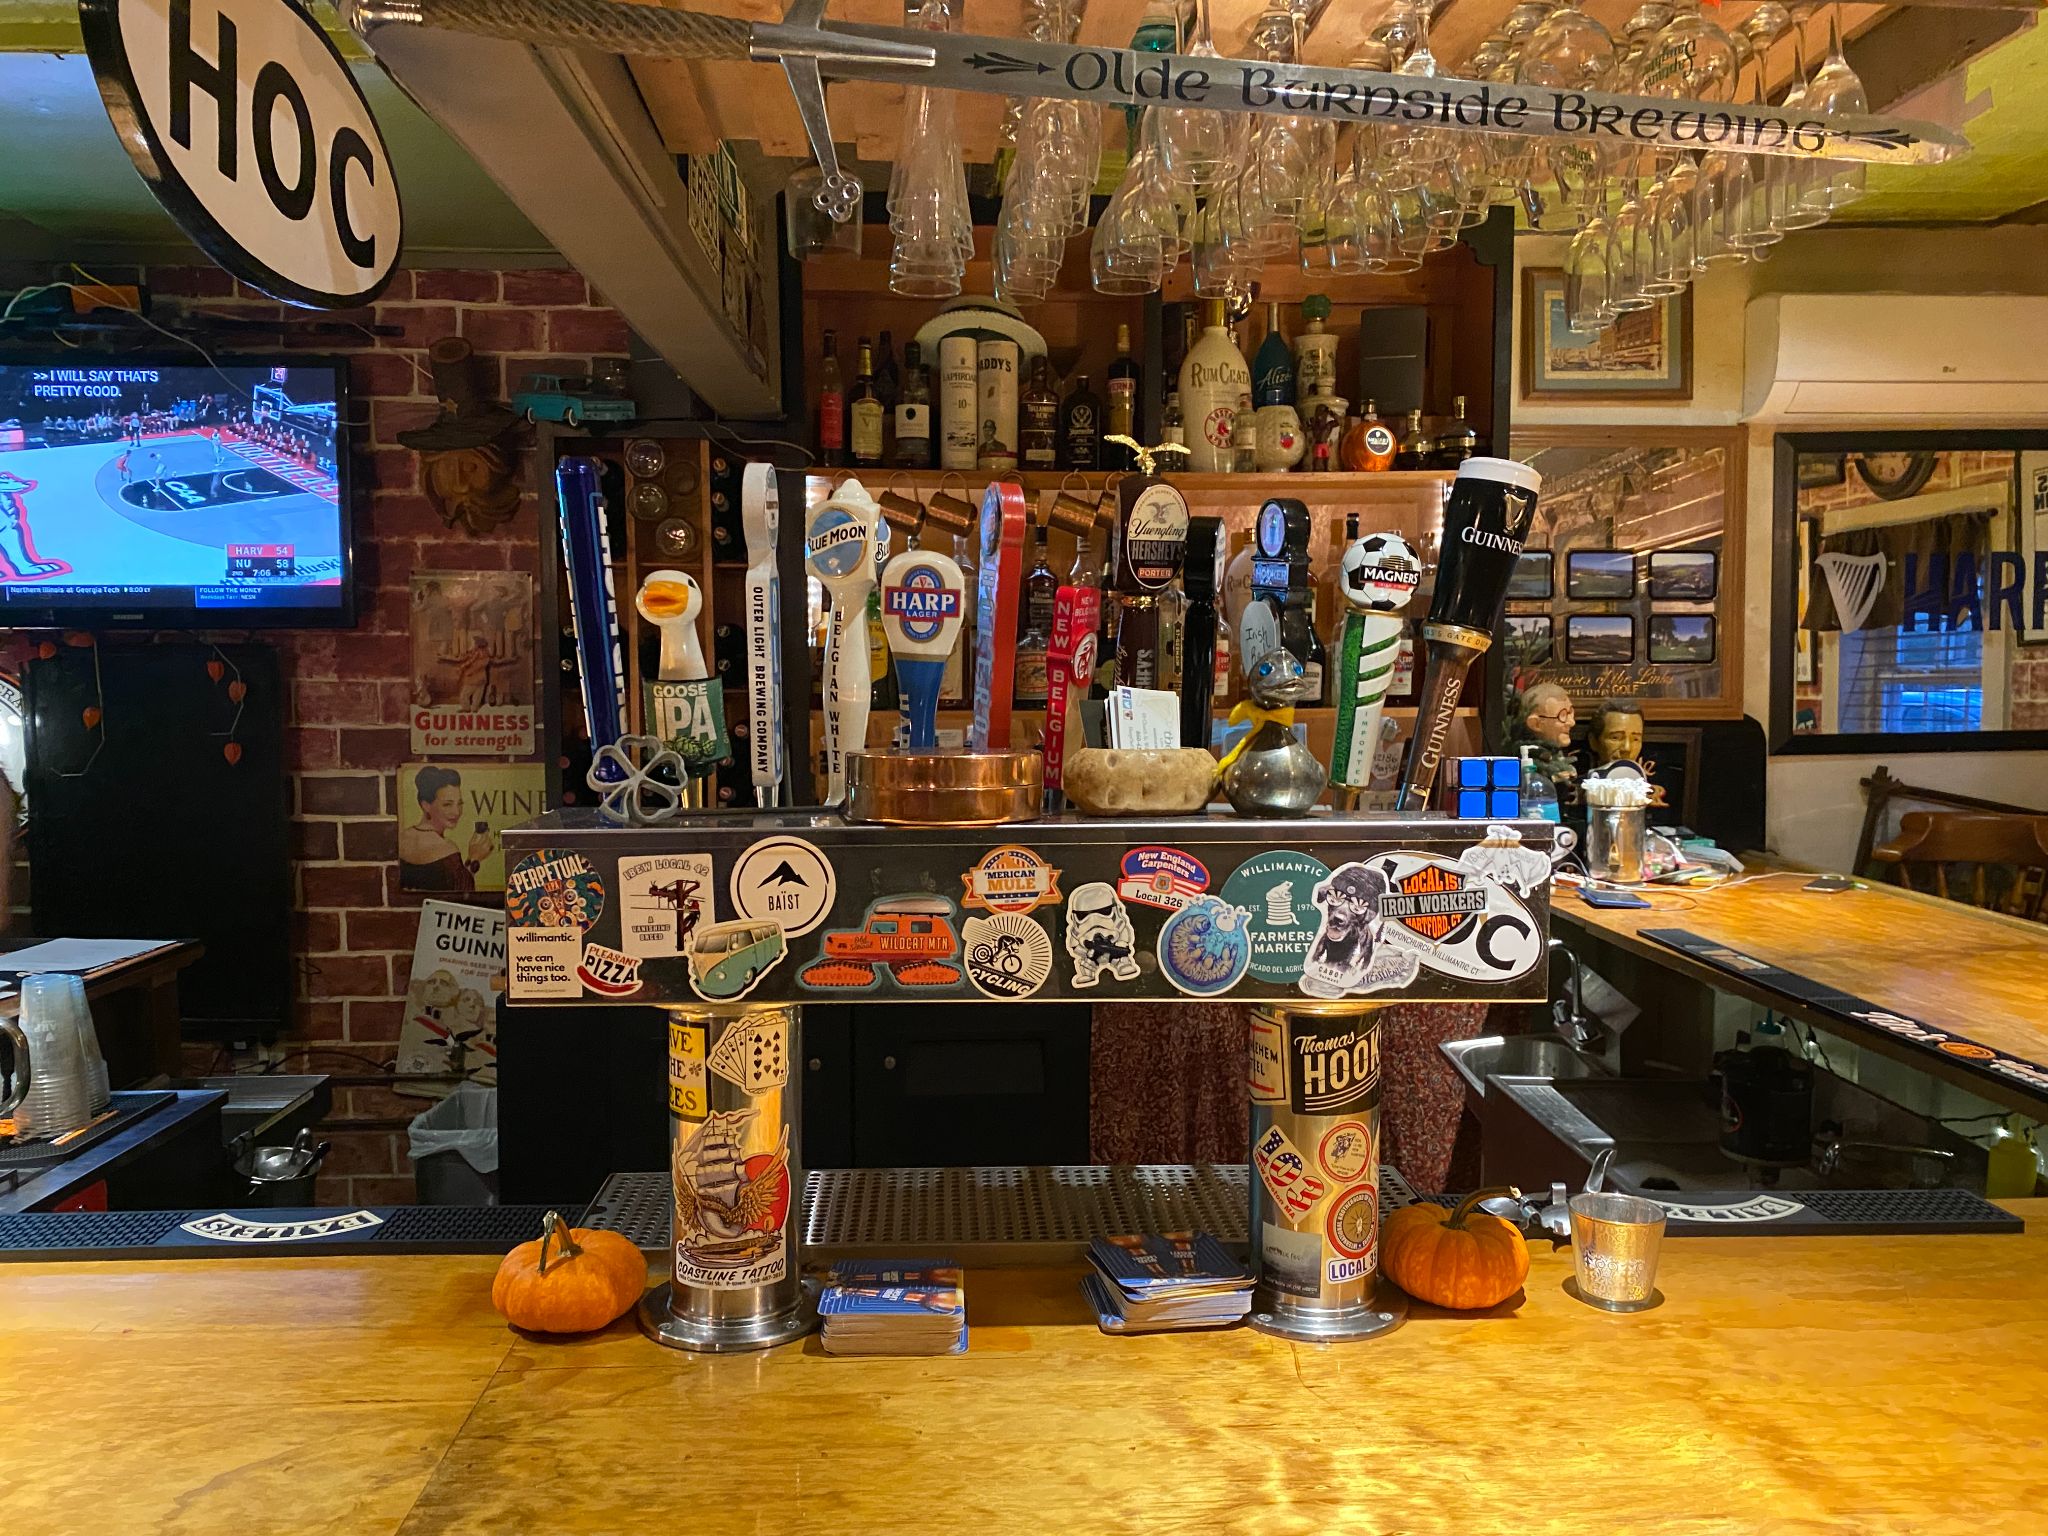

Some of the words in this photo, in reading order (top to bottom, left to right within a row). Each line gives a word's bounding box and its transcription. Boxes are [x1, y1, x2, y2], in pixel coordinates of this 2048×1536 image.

[1065, 51, 1211, 101] Olde
[1241, 67, 1528, 128] Burnside
[1550, 91, 1826, 152] Brewing
[168, 0, 376, 268] HOC
[57, 370, 87, 381] WILL
[88, 370, 113, 381] SAY
[114, 370, 159, 382] THAT'S
[34, 385, 81, 397] PRETTY
[84, 385, 122, 397] GOOD.
[830, 524, 867, 543] MOON
[1129, 517, 1185, 540] Yuengling
[235, 546, 263, 555] HARV
[276, 546, 288, 555] 54
[1461, 526, 1523, 555] GUINNES
[235, 559, 251, 568] NU
[276, 559, 289, 568] 58
[253, 569, 271, 577] 7:06
[1139, 568, 1172, 578] PORTER
[1363, 567, 1419, 585] MAGNERS
[75, 586, 102, 595] Georgia
[892, 591, 955, 612] HARP
[753, 586, 763, 623] OUTER
[906, 610, 938, 618] LAGER
[754, 626, 765, 659] LIGHT
[830, 610, 843, 703] BELGIAN
[653, 683, 707, 698] GOOSE
[755, 665, 767, 717] BREWING
[1612, 684, 1639, 694] GOLF
[414, 711, 530, 732] GUINNESS
[654, 696, 718, 741] IPA
[1045, 669, 1065, 781] BELGIUM
[1421, 677, 1461, 770] GUINNESS
[424, 733, 448, 747] for
[454, 734, 522, 751] strength
[756, 720, 768, 773] COMPANY
[828, 710, 841, 775] WHITE
[1353, 711, 1368, 784] IMPORTED
[622, 860, 652, 881] IBEW
[655, 858, 691, 870] LOCAL
[693, 863, 710, 877] 42
[1138, 850, 1159, 862] New
[1160, 851, 1196, 874] England
[1141, 858, 1190, 878] Carpenters
[1240, 862, 1323, 878] WILLIMANTIC
[513, 854, 588, 893] PERPETUAL
[985, 869, 1036, 879] 'MERICAN
[1403, 872, 1444, 895] LOCAL
[987, 878, 1036, 892] MULE
[1135, 889, 1161, 904] Local
[1163, 896, 1184, 908] 326
[1382, 895, 1418, 918] IRON
[1421, 891, 1485, 914] WORKERS
[434, 911, 485, 934] TIME
[1405, 914, 1452, 940] HARTFORD,
[435, 933, 505, 960] GUINN
[516, 932, 576, 942] willimantic.
[880, 937, 924, 951] WILDCAT
[1250, 931, 1314, 942] FARMERS
[516, 955, 532, 963] we
[534, 955, 554, 963] can
[588, 946, 639, 968] PLEASANT
[1255, 942, 1311, 954] MARKET
[516, 963, 543, 972] have
[544, 963, 565, 972] nice
[516, 973, 549, 984] things
[550, 973, 571, 982] too.
[584, 955, 636, 984] PIZZA
[1271, 963, 1284, 973] DEL
[1318, 966, 1344, 980] CABOT
[970, 967, 1031, 996] CYCLING
[746, 1029, 755, 1037] 10
[1294, 1031, 1355, 1055] Thomas
[1304, 1024, 1380, 1094] HOOK
[1255, 1128, 1325, 1213] 103
[1265, 1174, 1285, 1207] Boston
[1283, 1203, 1296, 1221] MA
[1667, 1201, 1790, 1219] BAILEY
[194, 1215, 361, 1239] BAILEYS
[677, 1259, 738, 1283] COASTLINE
[741, 1256, 785, 1280] TATTOO
[1330, 1258, 1368, 1281] LOCAL
